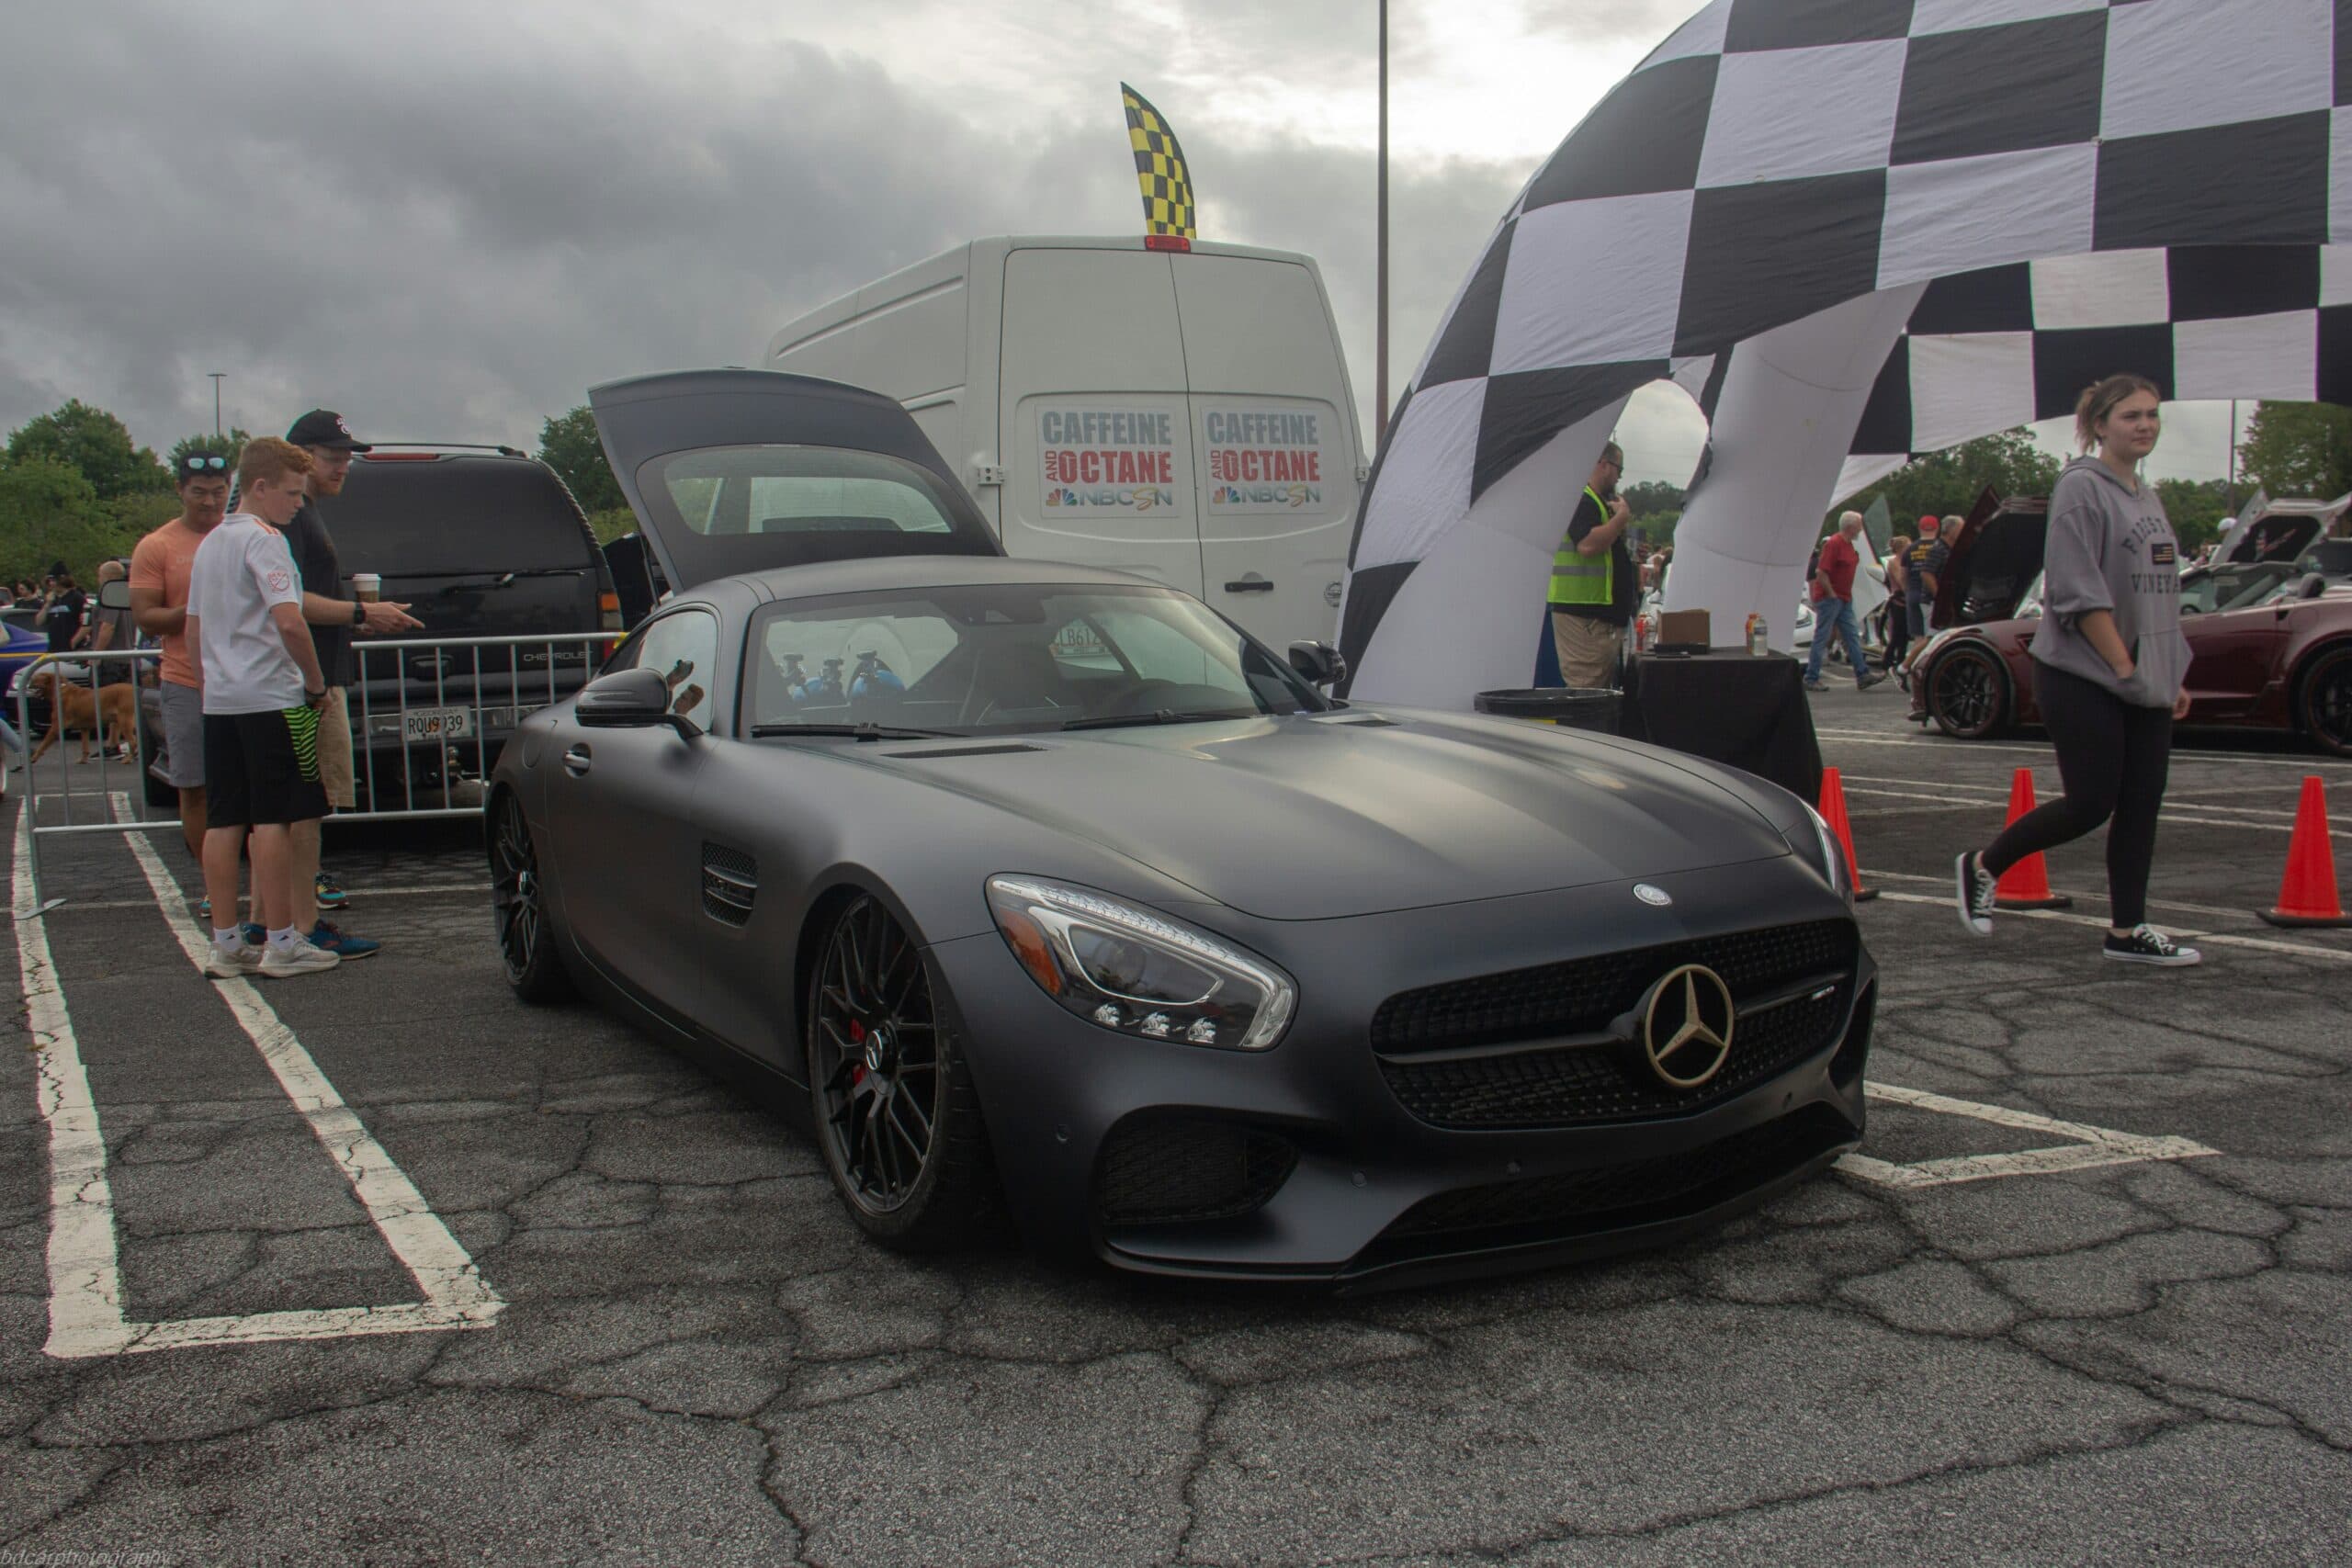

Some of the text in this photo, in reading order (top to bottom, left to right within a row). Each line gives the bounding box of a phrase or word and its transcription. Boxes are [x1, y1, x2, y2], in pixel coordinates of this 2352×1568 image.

[1042, 411, 1172, 445] CAFFEINE
[1206, 412, 1319, 445] CAFFEINE
[1045, 450, 1173, 484] AND OCTANE
[1210, 449, 1321, 482] AND OCTANE
[1080, 486, 1173, 511] NBCSN
[1241, 484, 1321, 507] NBCSN
